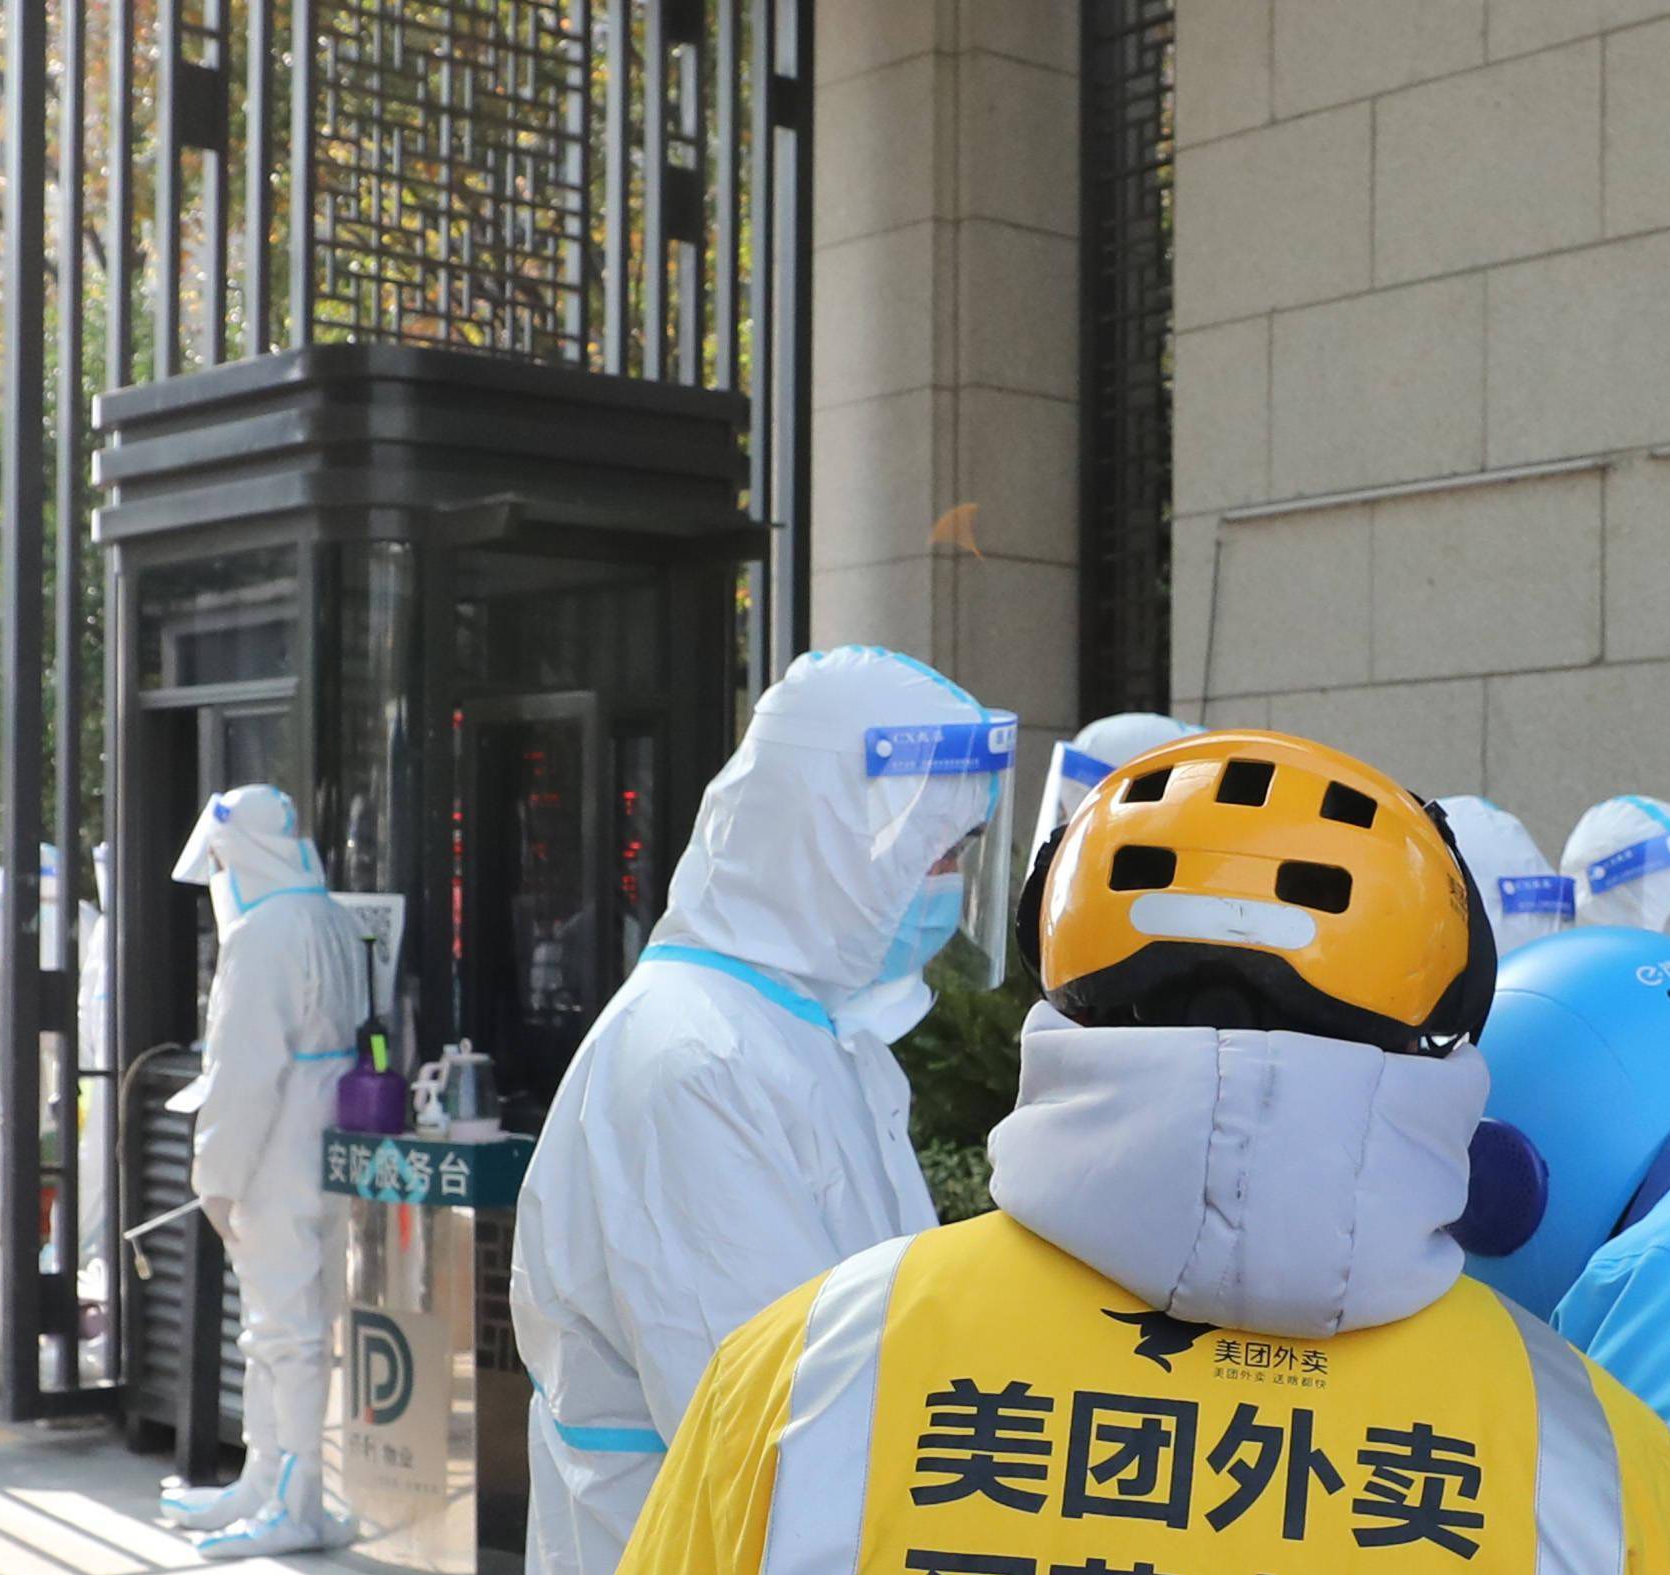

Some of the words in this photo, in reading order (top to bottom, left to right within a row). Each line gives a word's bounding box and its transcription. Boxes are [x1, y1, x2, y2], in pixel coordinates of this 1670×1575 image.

[327, 1139, 471, 1198] 安防服务台
[1214, 1339, 1329, 1376] 美团外卖
[909, 1377, 1486, 1561] 美团外卖
